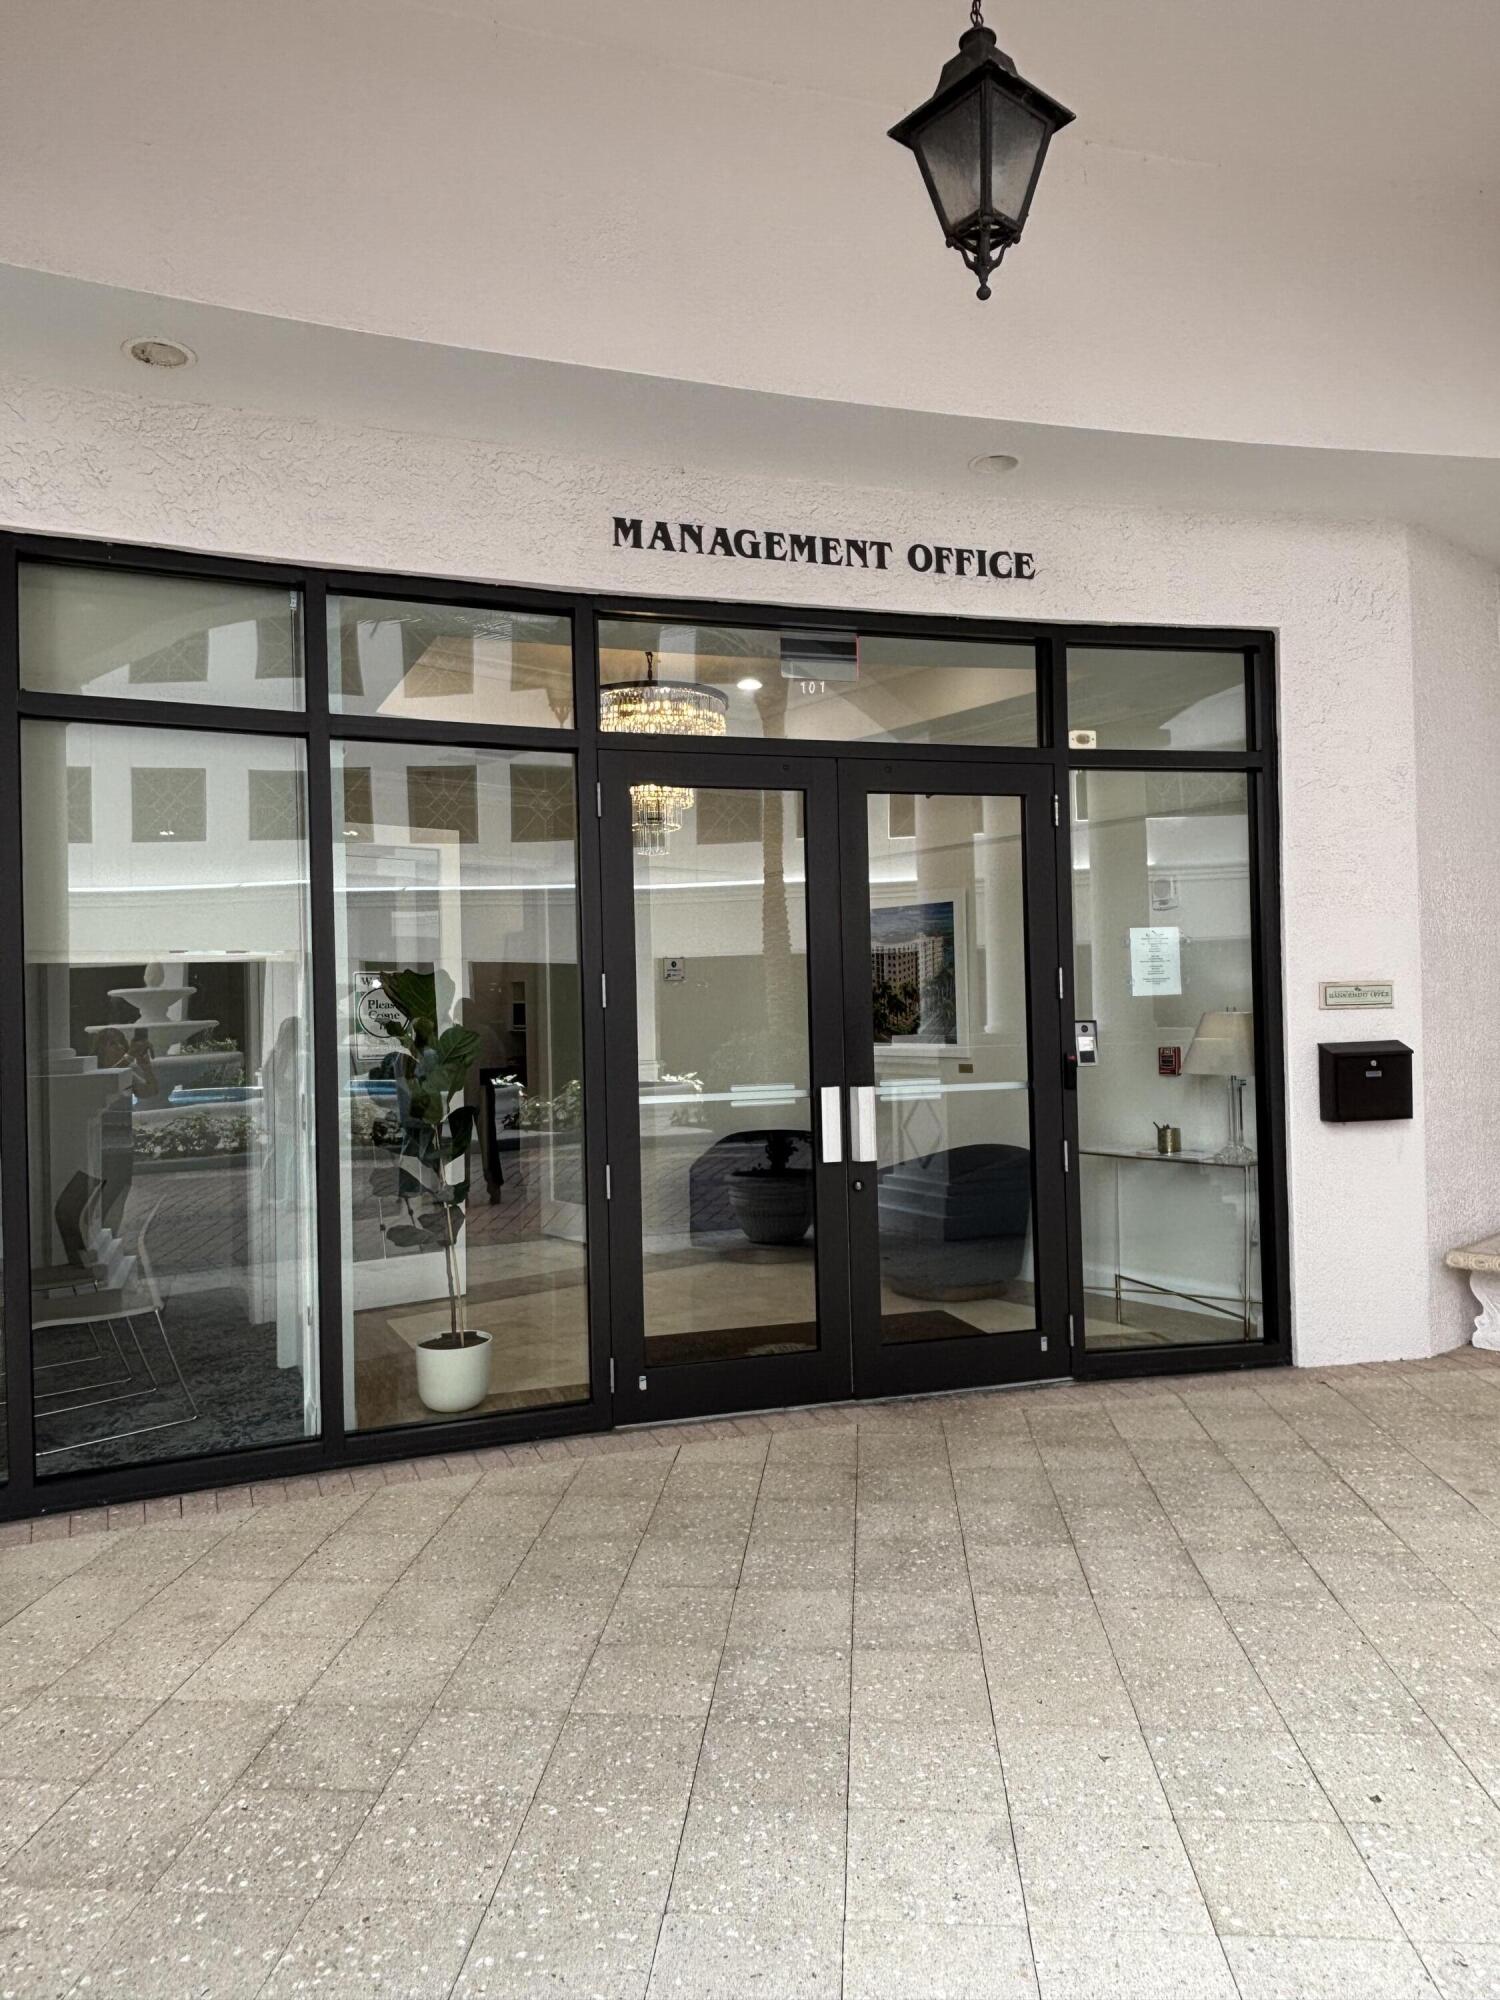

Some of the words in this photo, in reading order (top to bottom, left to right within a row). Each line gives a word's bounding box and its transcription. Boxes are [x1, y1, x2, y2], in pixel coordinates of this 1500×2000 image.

[612, 516, 893, 570] MANAGEMENT
[907, 543, 1036, 580] OFFICE
[799, 681, 825, 695] 101
[368, 999, 397, 1010] Pleas
